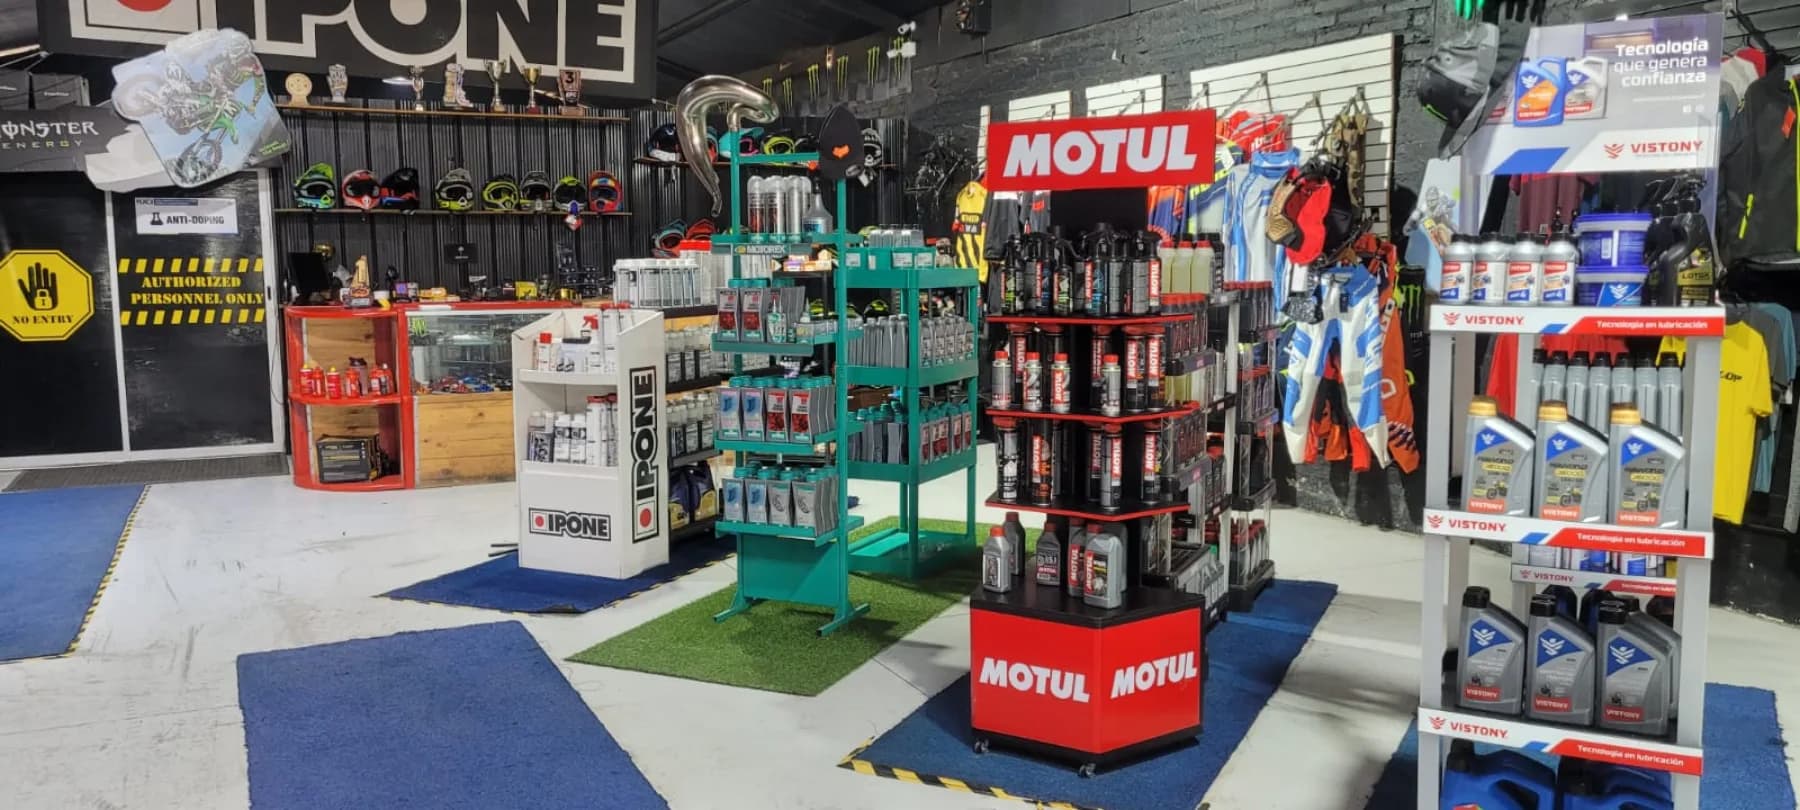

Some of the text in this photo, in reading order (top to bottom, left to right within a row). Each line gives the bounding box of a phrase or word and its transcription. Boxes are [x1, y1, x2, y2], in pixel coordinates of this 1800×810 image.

[1615, 37, 1709, 57] Tecnología
[1614, 55, 1707, 74] que genera
[565, 71, 574, 83] 3
[1622, 71, 1706, 87] confianza
[0, 120, 99, 139] ONSTER
[2, 140, 82, 149] ENERGY
[1003, 125, 1197, 177] MOTUL
[1630, 141, 1703, 153] VISTONY
[166, 216, 225, 224] ANTI-DOPING
[142, 276, 242, 288] AUTHORIZED
[1151, 263, 1159, 296] MOTUL
[131, 293, 264, 305] PERSONNEL ONLY
[13, 315, 73, 324] NO ENTRY
[1465, 316, 1524, 325] VISTONY
[1597, 321, 1644, 330] Tecnología
[1658, 320, 1708, 329] lubricación
[1127, 342, 1136, 377] MOTUL
[1149, 338, 1159, 374] MOTUL
[1054, 372, 1063, 400] MOTUL
[634, 373, 655, 501] IPONE
[1112, 441, 1120, 475] MOTUL
[1145, 436, 1155, 470] MOTUL
[1470, 502, 1503, 510] VISTONY
[1543, 508, 1577, 517] VISTONY
[548, 514, 608, 537] IPONE
[1448, 520, 1507, 532] VISTONY
[1577, 533, 1624, 545] Tecnología
[1636, 537, 1685, 547] lubricación
[1071, 549, 1079, 582] MOTUL
[1534, 572, 1574, 582] VISTONY
[979, 657, 1090, 703] MOTUL
[1110, 651, 1197, 699] MOTUL
[1466, 688, 1498, 698] VISTONY
[1536, 699, 1568, 710] VISTONY
[1606, 709, 1640, 718] VISTONY
[1450, 722, 1508, 739] VISTONY
[1577, 744, 1624, 758] Tecnología
[1637, 753, 1684, 767] lubricación
